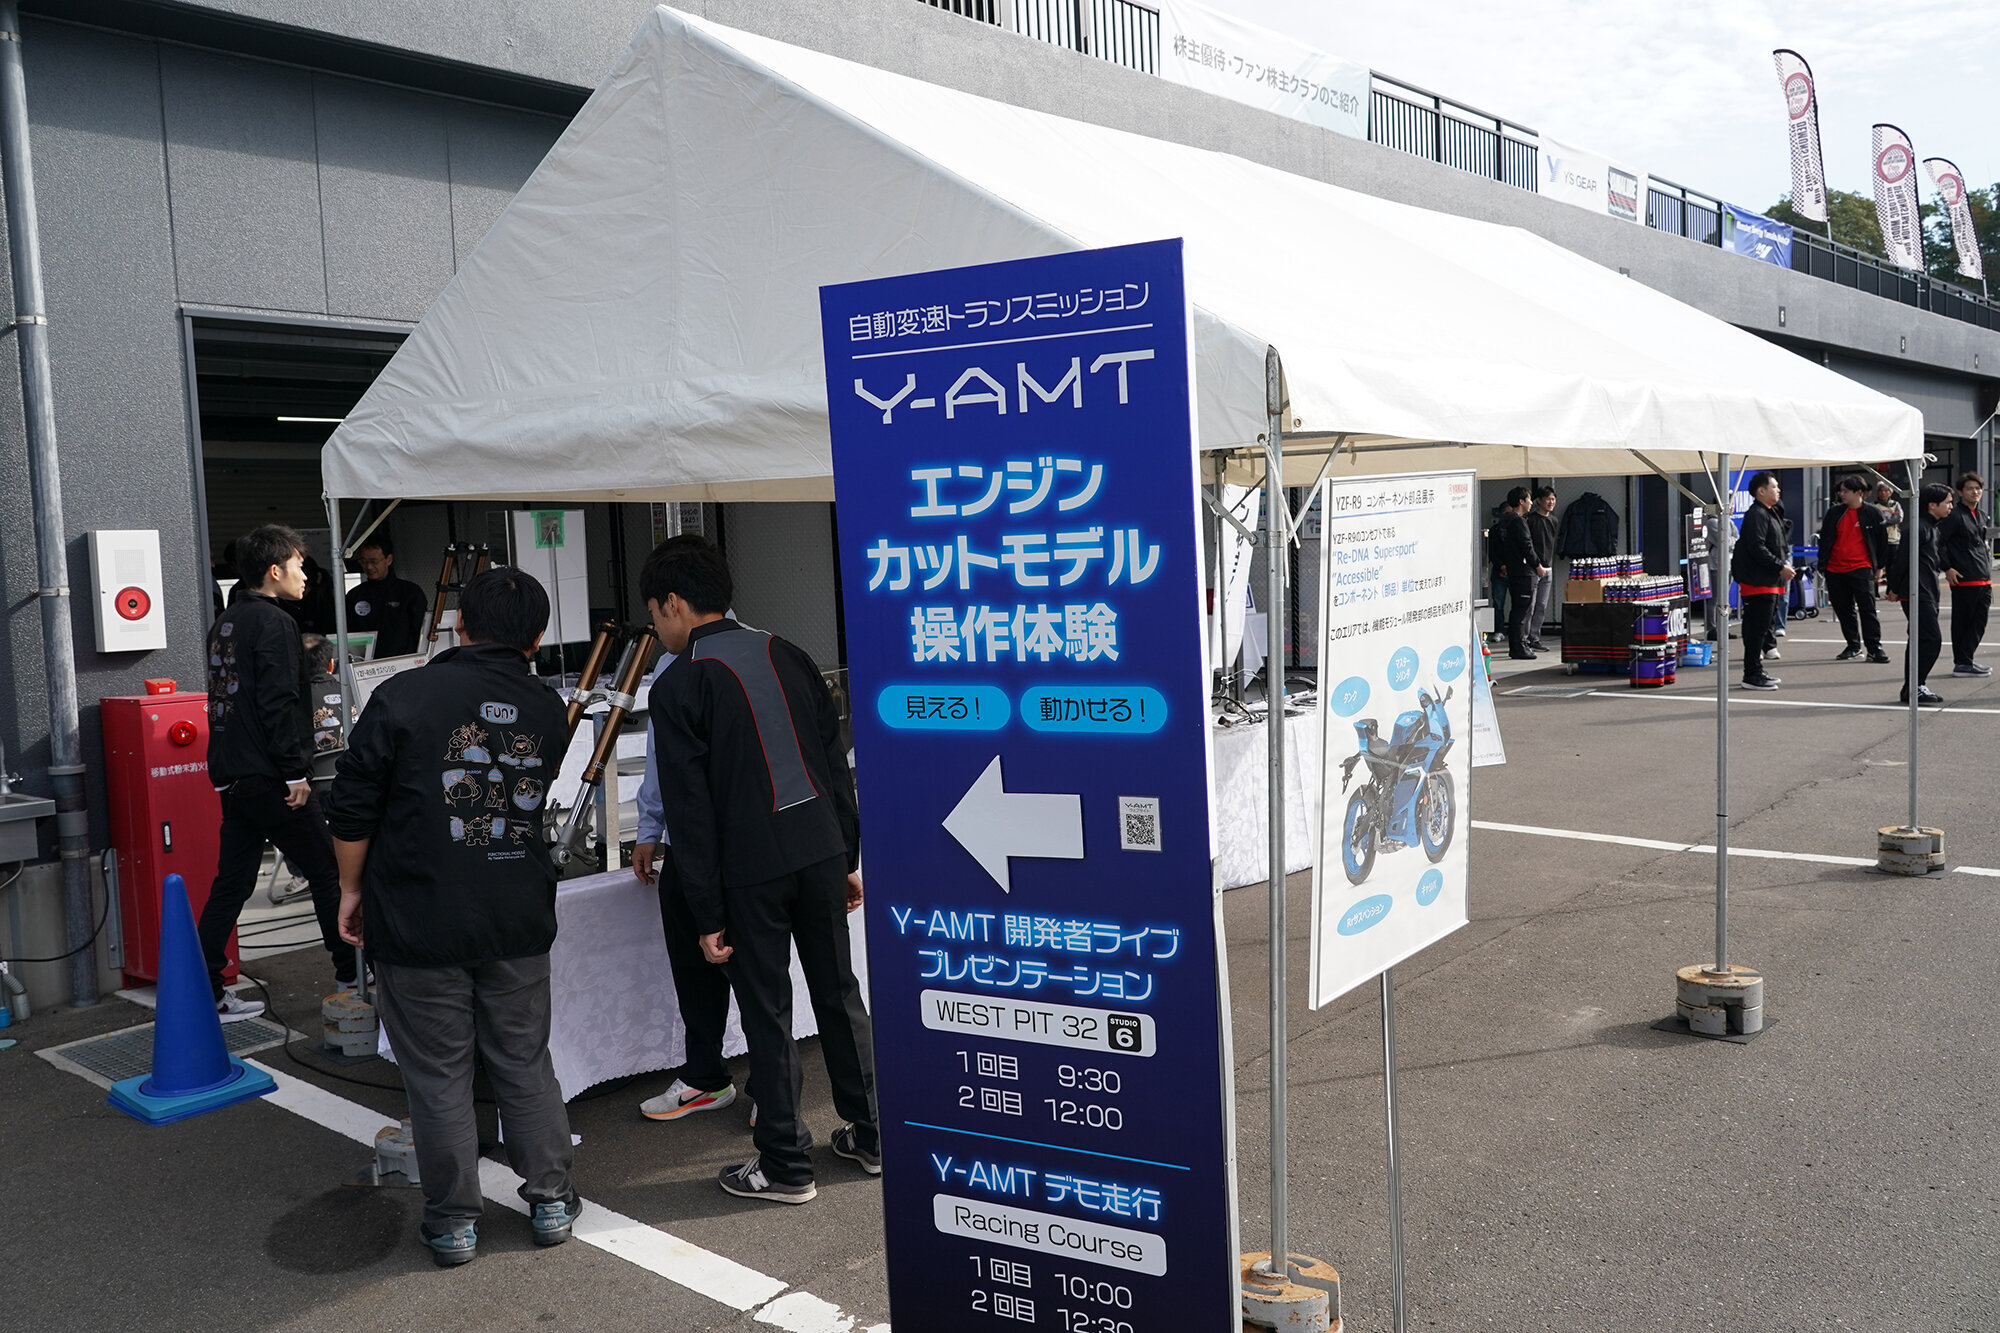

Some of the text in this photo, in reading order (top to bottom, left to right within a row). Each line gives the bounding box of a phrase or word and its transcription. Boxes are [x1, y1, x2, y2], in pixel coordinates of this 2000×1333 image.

[1575, 174, 1598, 193] GEAR
[848, 281, 1149, 341] 自動変速トランスミッション
[854, 348, 1155, 425] Y-AMT
[910, 456, 1104, 518] エンジン
[1335, 494, 1362, 511] YZF-R9
[866, 526, 1161, 592] カットモデル
[910, 602, 1120, 663] 操作体験
[890, 906, 1180, 959] Y-AMT 開発者ライブ
[918, 949, 1153, 1001] プレゼンテーション
[936, 999, 1099, 1041] WEST PIT 32
[1109, 1017, 1138, 1028] STUDIO
[1115, 1027, 1135, 1048] 6
[1057, 1064, 1122, 1095] 9:30
[1044, 1099, 1124, 1131] 12:00
[931, 1152, 1162, 1222] Y-AMT デモ走行
[954, 1204, 1144, 1263] Racing Course
[1054, 1272, 1133, 1310] 10:00
